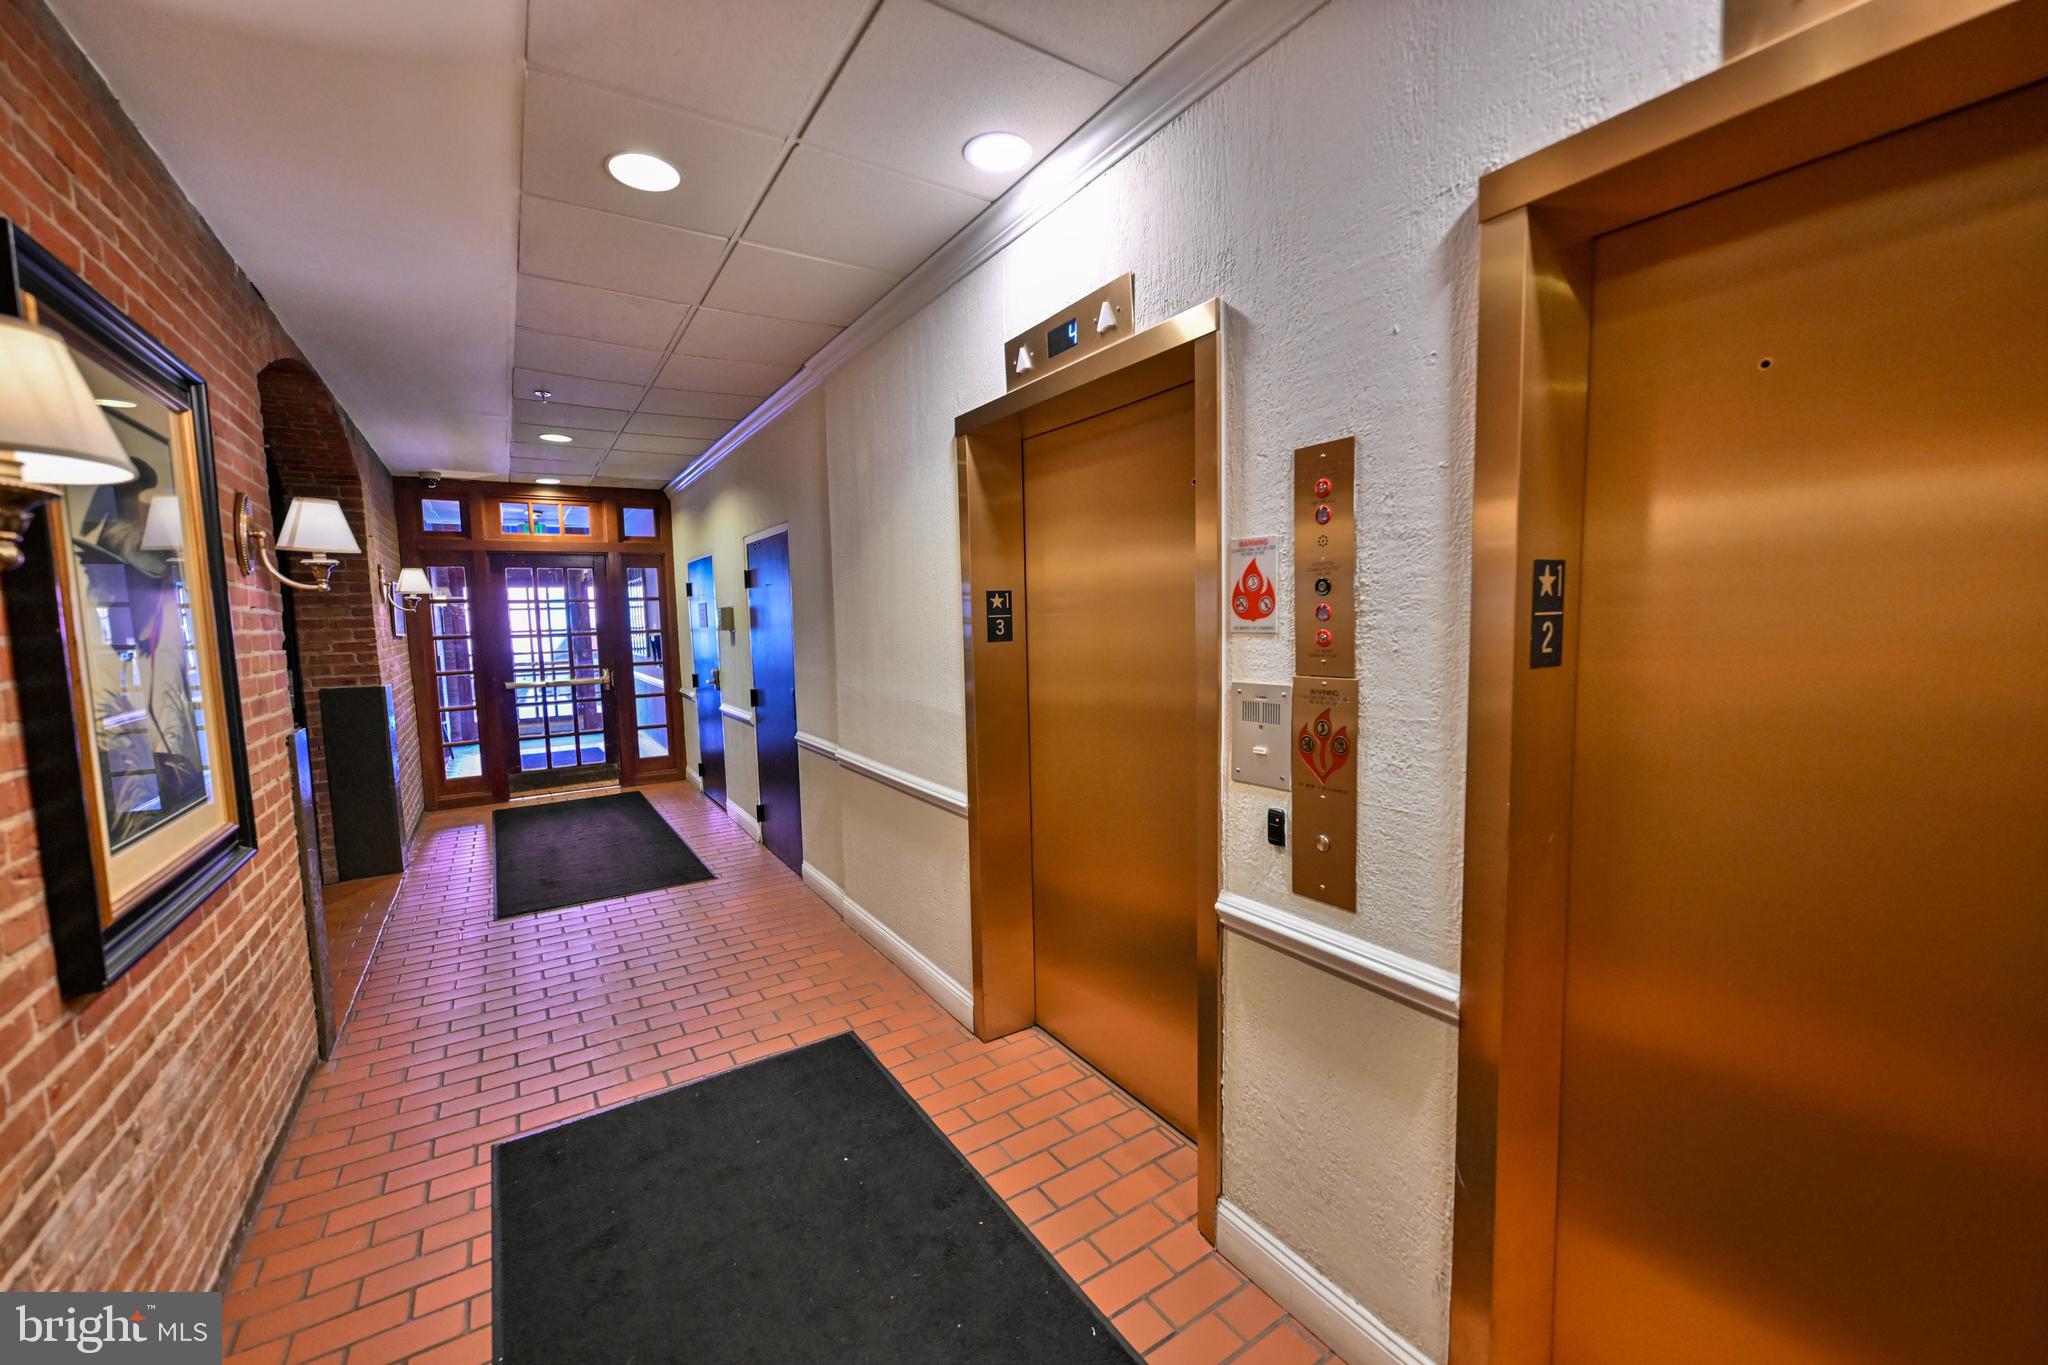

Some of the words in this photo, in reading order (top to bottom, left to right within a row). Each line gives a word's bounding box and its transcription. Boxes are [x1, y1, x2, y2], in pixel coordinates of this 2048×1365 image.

[1068, 320, 1078, 345] 4
[1238, 538, 1269, 548] WARNING
[996, 619, 1005, 635] 3
[1541, 620, 1554, 654] 2
